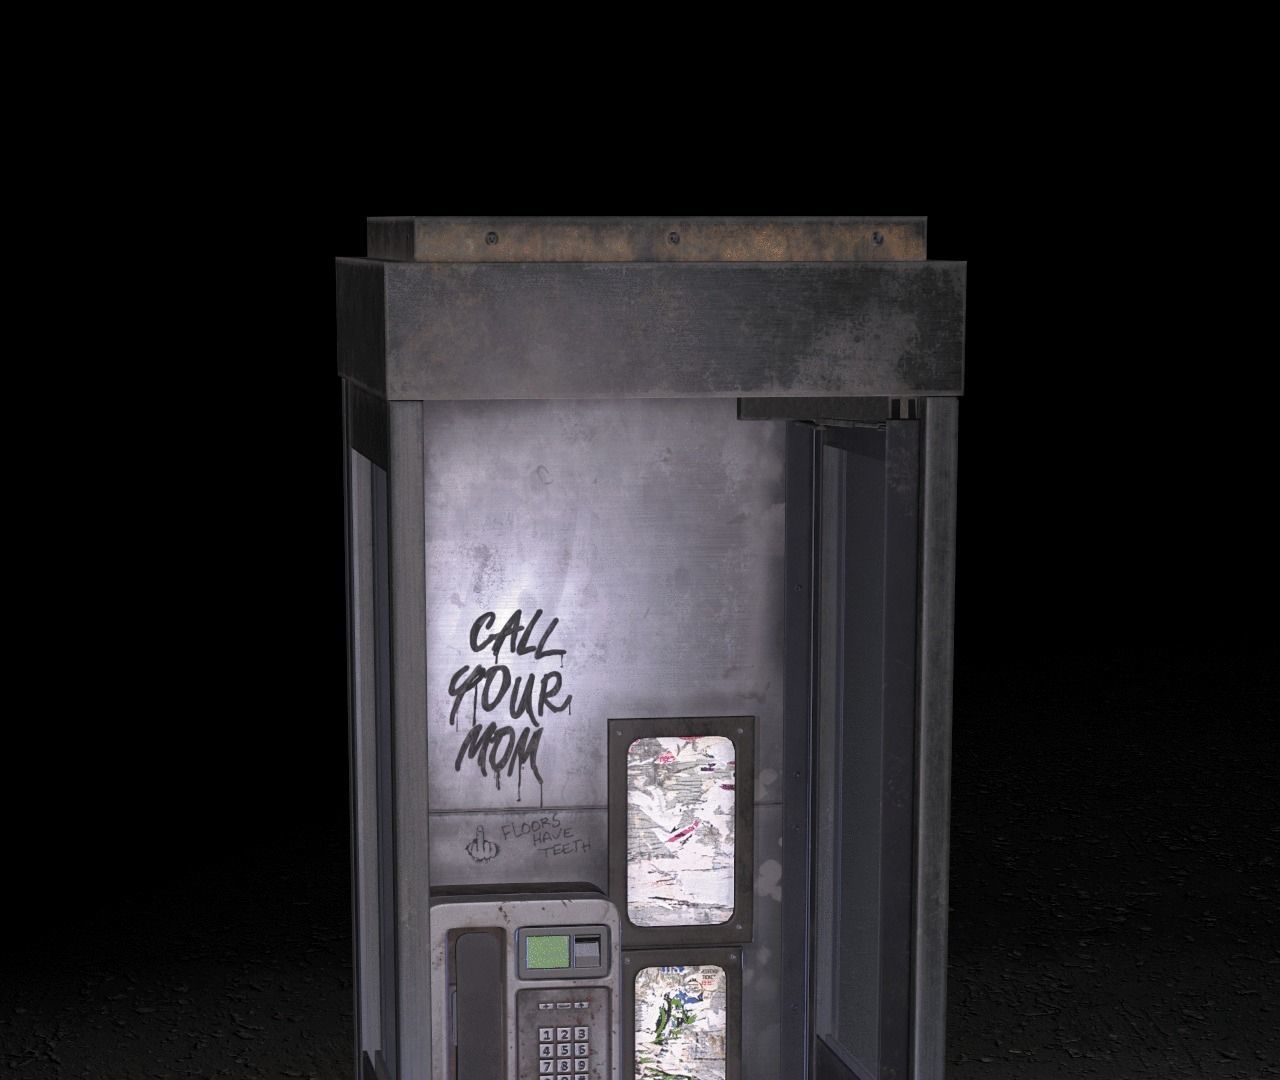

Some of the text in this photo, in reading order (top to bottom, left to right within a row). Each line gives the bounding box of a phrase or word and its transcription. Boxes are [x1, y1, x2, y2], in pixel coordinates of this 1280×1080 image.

[470, 609, 566, 663] CALL
[448, 664, 572, 727] YOUR
[455, 722, 543, 786] MOM
[501, 813, 560, 841] FLOORS
[533, 827, 574, 847] HAVE
[537, 838, 591, 858] TEETH
[543, 1029, 586, 1040] 1 2 3
[543, 1046, 550, 1056] 4
[561, 1045, 568, 1055] 5
[544, 1060, 585, 1072] 7 8 9
